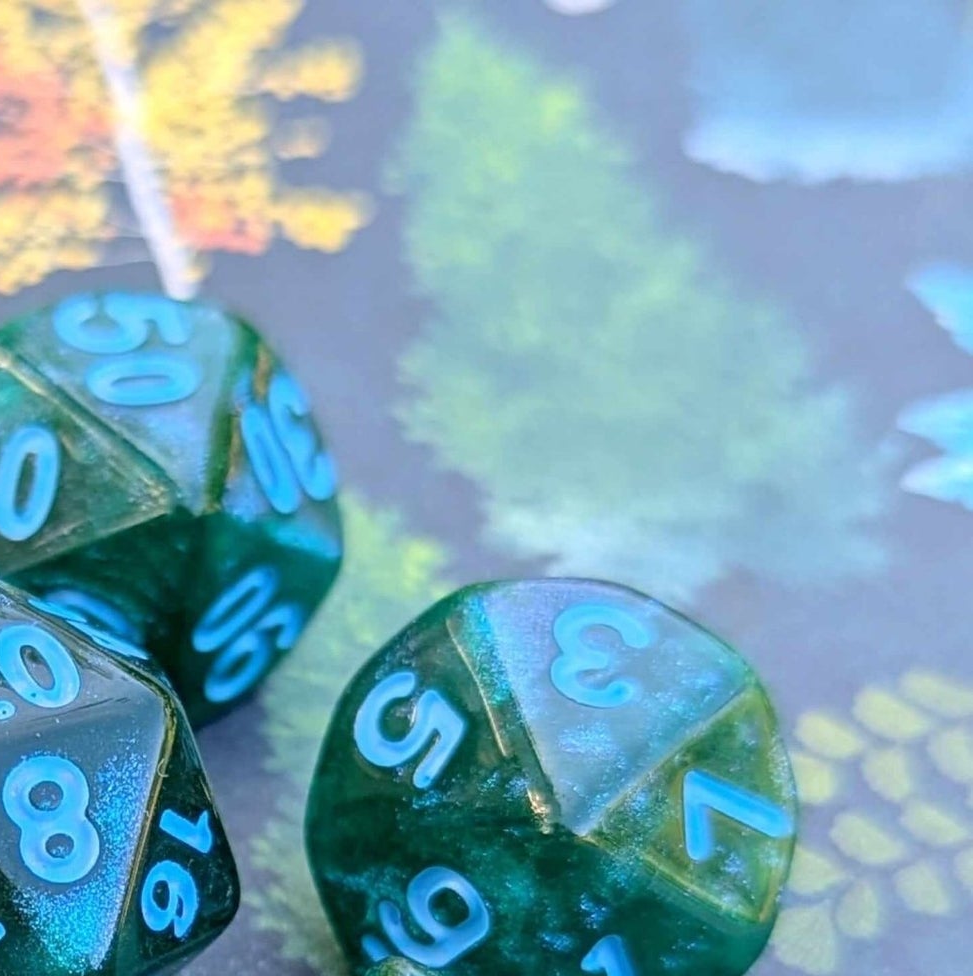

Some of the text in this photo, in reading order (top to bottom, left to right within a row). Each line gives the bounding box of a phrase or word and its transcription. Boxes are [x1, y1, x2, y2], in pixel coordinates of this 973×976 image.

[551, 603, 659, 709] 3
[354, 672, 467, 789] 5
[2, 756, 100, 883] 8
[682, 768, 794, 861] 7
